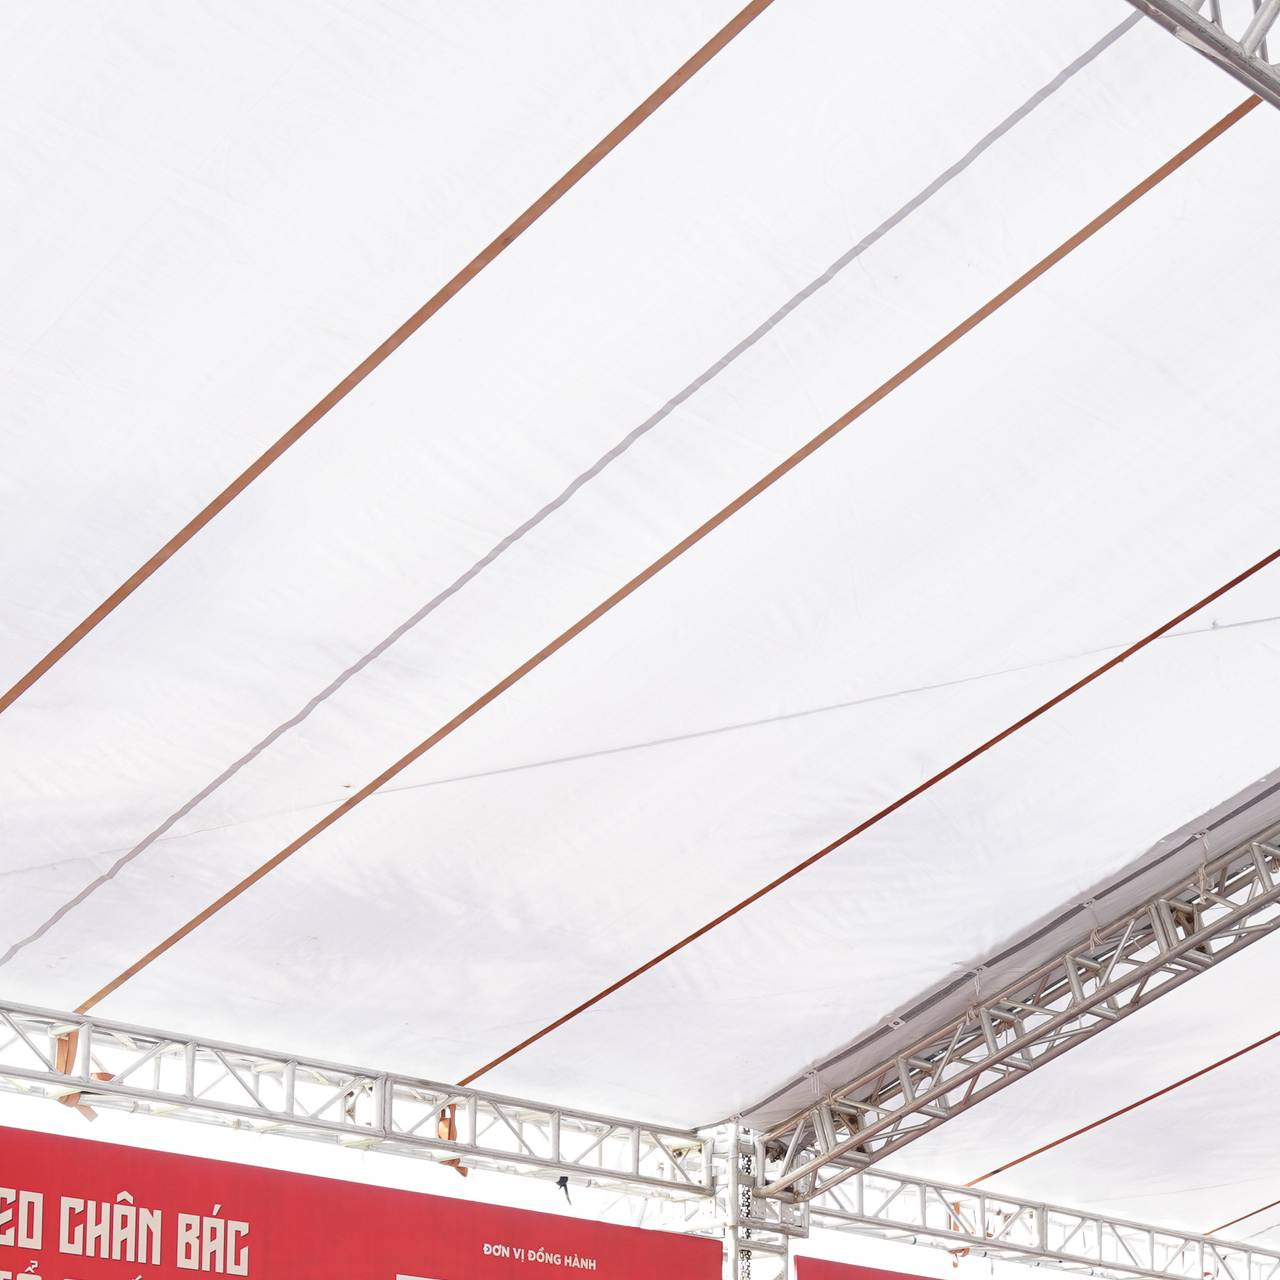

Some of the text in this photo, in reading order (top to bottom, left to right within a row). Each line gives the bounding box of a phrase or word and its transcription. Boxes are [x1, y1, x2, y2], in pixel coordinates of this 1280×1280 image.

[60, 1192, 162, 1266] CHÂN
[177, 1205, 250, 1276] BÁC
[483, 1243, 596, 1270] ĐƠN VỊ ĐỒNG HÀNH
